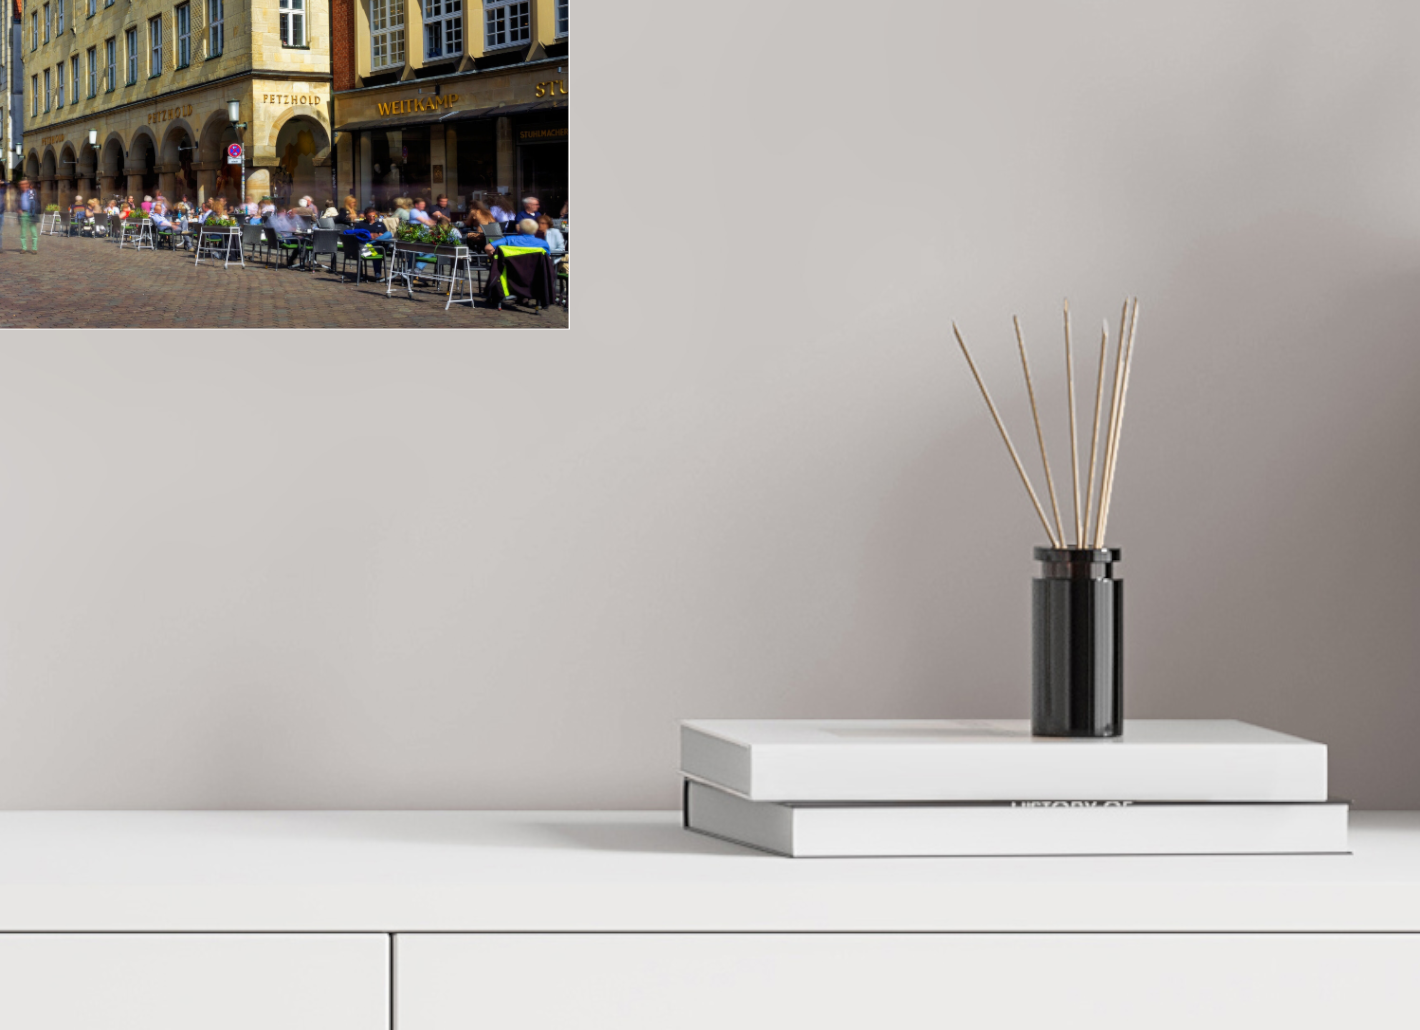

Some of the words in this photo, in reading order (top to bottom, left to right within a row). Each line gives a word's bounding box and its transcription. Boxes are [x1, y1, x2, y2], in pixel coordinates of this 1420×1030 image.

[263, 94, 321, 106] PETZHOLD
[377, 93, 460, 116] WEITKAMP
[147, 104, 193, 125] PETZHOLD
